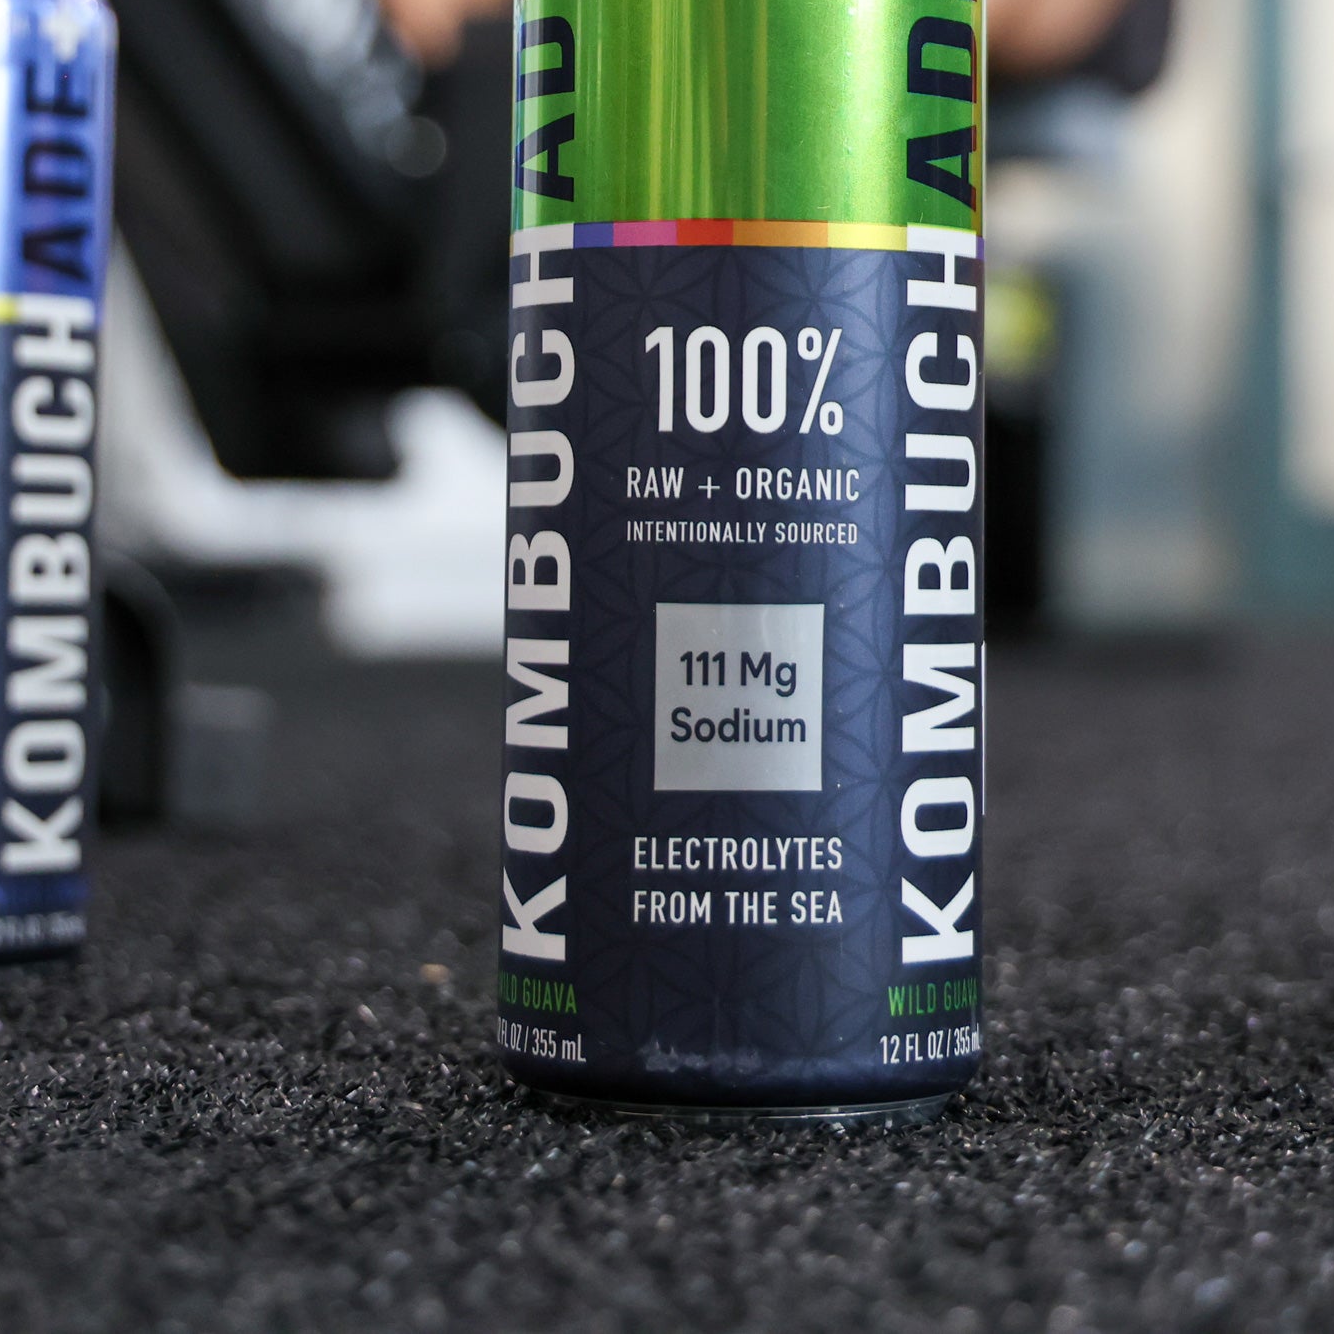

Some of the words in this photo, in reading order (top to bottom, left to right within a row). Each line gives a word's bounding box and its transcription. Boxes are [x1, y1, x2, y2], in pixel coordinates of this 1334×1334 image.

[644, 324, 844, 436] 100%
[626, 467, 684, 500] RAW
[735, 467, 861, 501] ORGANIC
[626, 520, 766, 545] INTENTIONALLY
[774, 521, 858, 545] SOURCED
[679, 651, 727, 686] 111
[740, 651, 798, 698] Mg
[670, 707, 807, 744] Sodium
[634, 836, 844, 871] ELECTROLYTES
[633, 889, 712, 924] FROM
[725, 890, 776, 924] THE
[790, 890, 844, 924] SEA
[522, 978, 577, 1015] GUAVA
[888, 982, 937, 1017] WILD
[510, 1023, 522, 1052] OZ
[532, 1027, 557, 1059] 355
[561, 1034, 587, 1062] mL
[879, 1035, 900, 1065] 12
[905, 1032, 923, 1063] FL
[927, 1029, 944, 1061] OZ
[954, 1026, 970, 1057] 355
